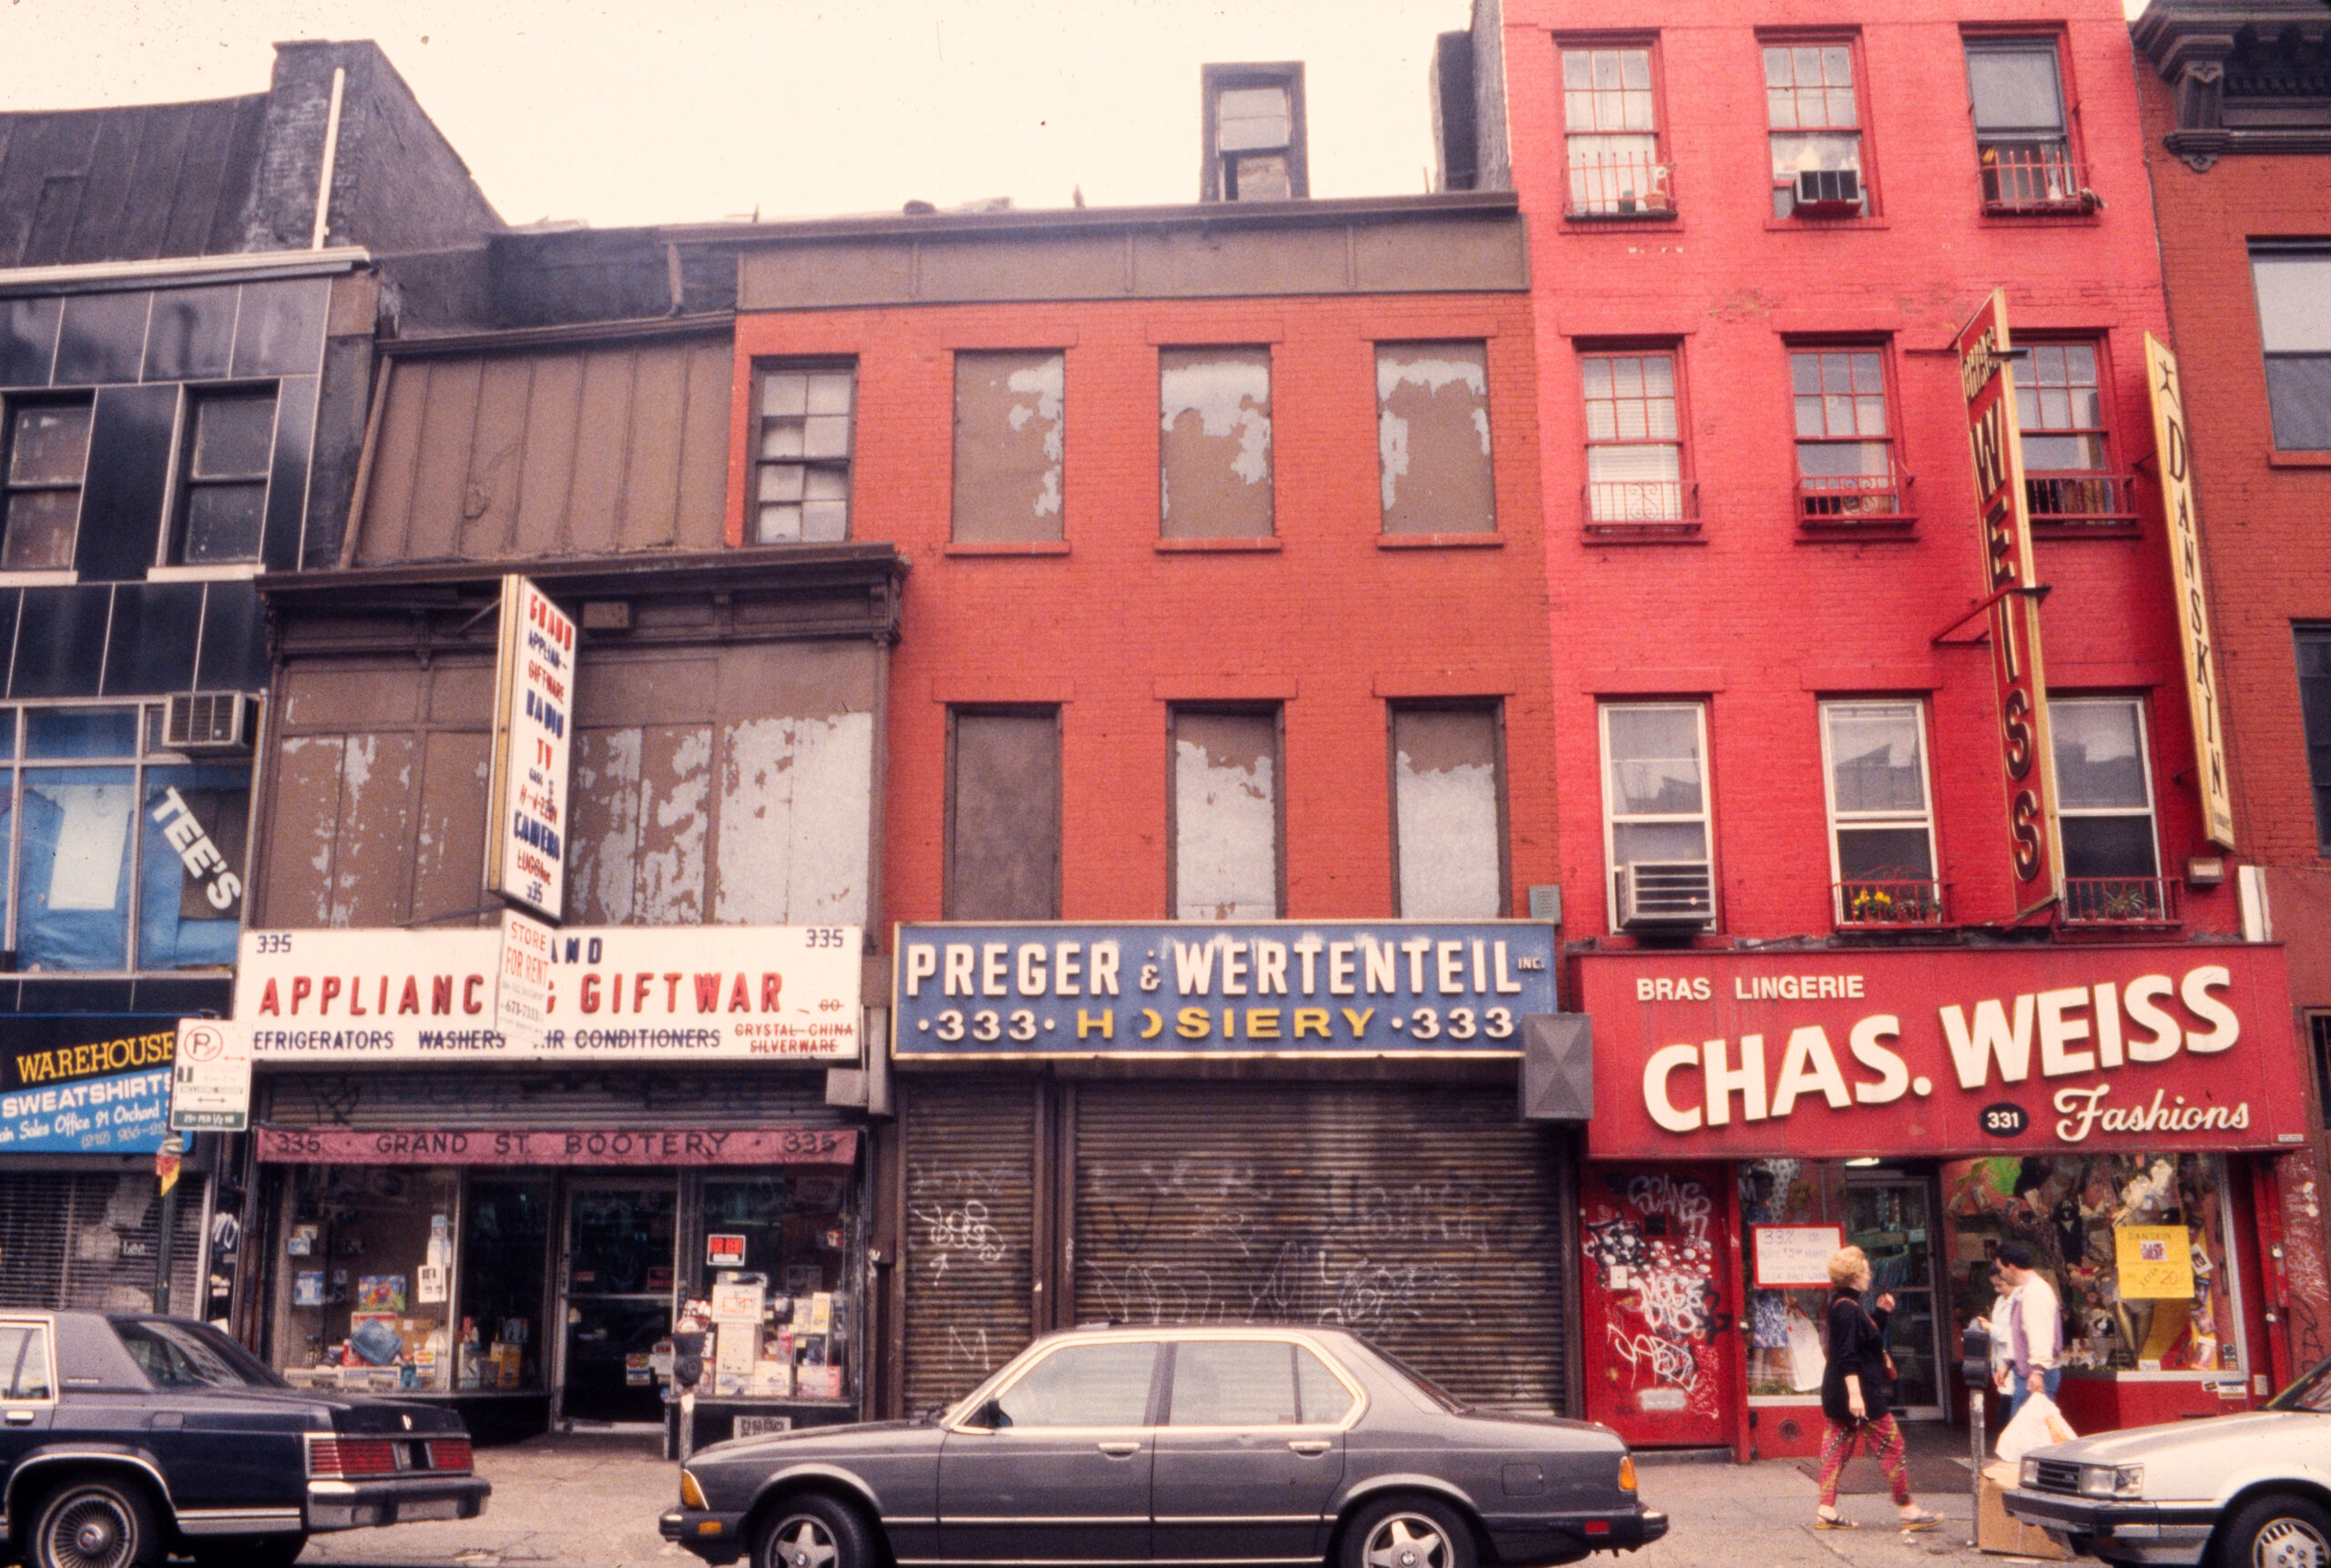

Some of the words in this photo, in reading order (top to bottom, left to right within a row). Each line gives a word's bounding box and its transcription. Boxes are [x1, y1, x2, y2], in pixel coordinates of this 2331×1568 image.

[529, 592, 573, 653] GRAND
[2167, 414, 2224, 799] DANSKIN
[1970, 395, 2041, 882] WEISS
[528, 658, 565, 705] GIFTWARE
[525, 688, 564, 740] RADIO
[536, 738, 554, 771] TV
[152, 784, 242, 911] TEE'S
[514, 808, 560, 861] CAMERA
[257, 933, 292, 954] 335
[510, 921, 547, 952] STORE
[806, 928, 844, 948] 335
[504, 945, 524, 979] FOR
[525, 954, 550, 988] RENT
[907, 942, 1121, 996] PREGER
[1139, 962, 1162, 992] &
[1175, 941, 1522, 995] WERTENTEIL
[1518, 956, 1545, 971] INC.
[580, 972, 783, 1014] GIFTWAR
[1636, 977, 1712, 1001] BRAS
[1735, 975, 1865, 999] LINGERIE
[252, 1030, 394, 1051] EFRIGERATORS
[418, 1030, 506, 1051] WASHERS
[534, 1029, 565, 1050] IR
[575, 1029, 722, 1049] CONDITIONERS
[749, 1038, 838, 1054] SILVERWARE
[808, 1023, 854, 1036] CHINA
[1643, 1013, 1933, 1133] CHAS.
[1939, 964, 2241, 1090] WEISS
[16, 1031, 176, 1084] WAREHOUSE
[20, 1118, 50, 1140] Sales
[55, 1112, 90, 1138] Office
[95, 1110, 109, 1129] 91
[114, 1098, 160, 1125] Orchard
[1986, 1110, 2021, 1129] 331
[2052, 1084, 2250, 1143] Fashions
[276, 1133, 321, 1155] 335
[376, 1133, 468, 1155] GRAND
[494, 1133, 532, 1156] ST.
[565, 1132, 729, 1156] BOOTERY
[783, 1132, 837, 1155] 335
[2127, 1231, 2172, 1240] DANSKIN
